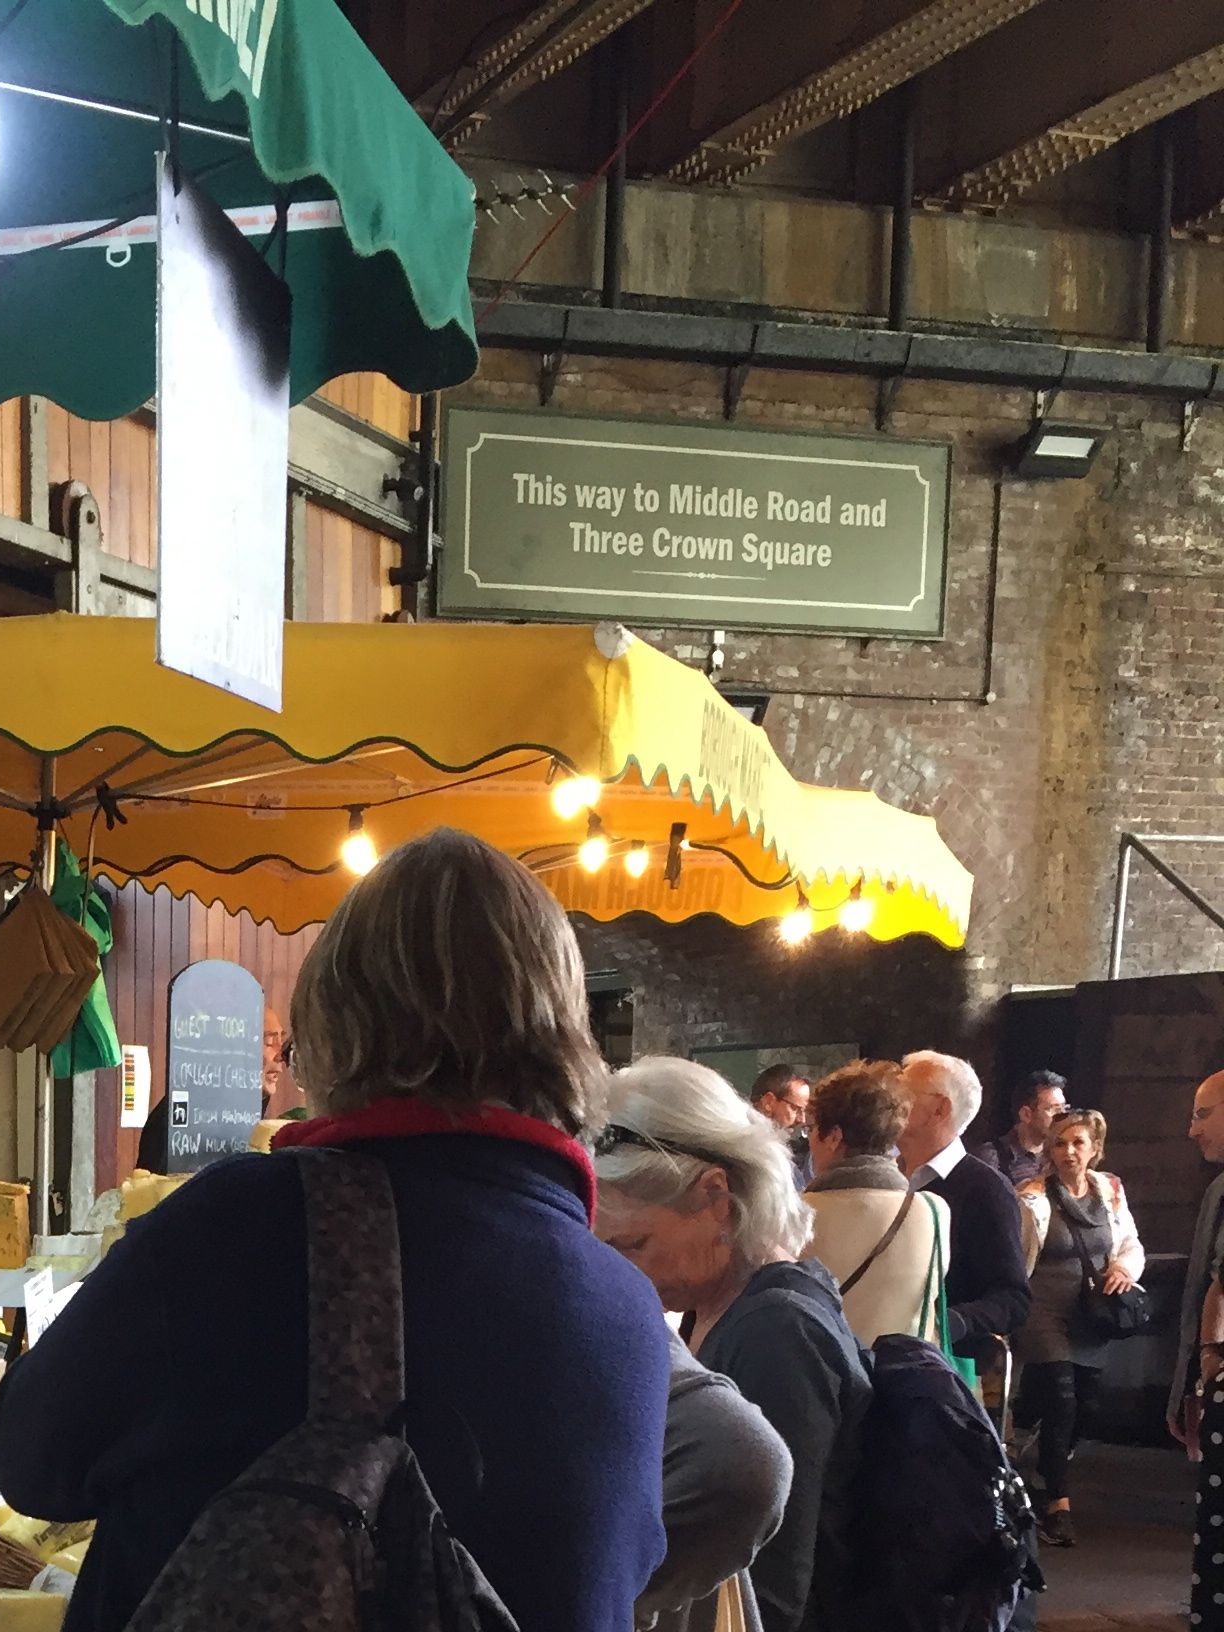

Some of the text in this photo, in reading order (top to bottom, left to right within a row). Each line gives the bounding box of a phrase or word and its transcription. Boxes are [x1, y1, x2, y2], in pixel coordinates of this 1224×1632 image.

[513, 473, 887, 528] This way to Middle Road and
[569, 522, 833, 570] Three Crown Square
[172, 1130, 201, 1156] RAW
